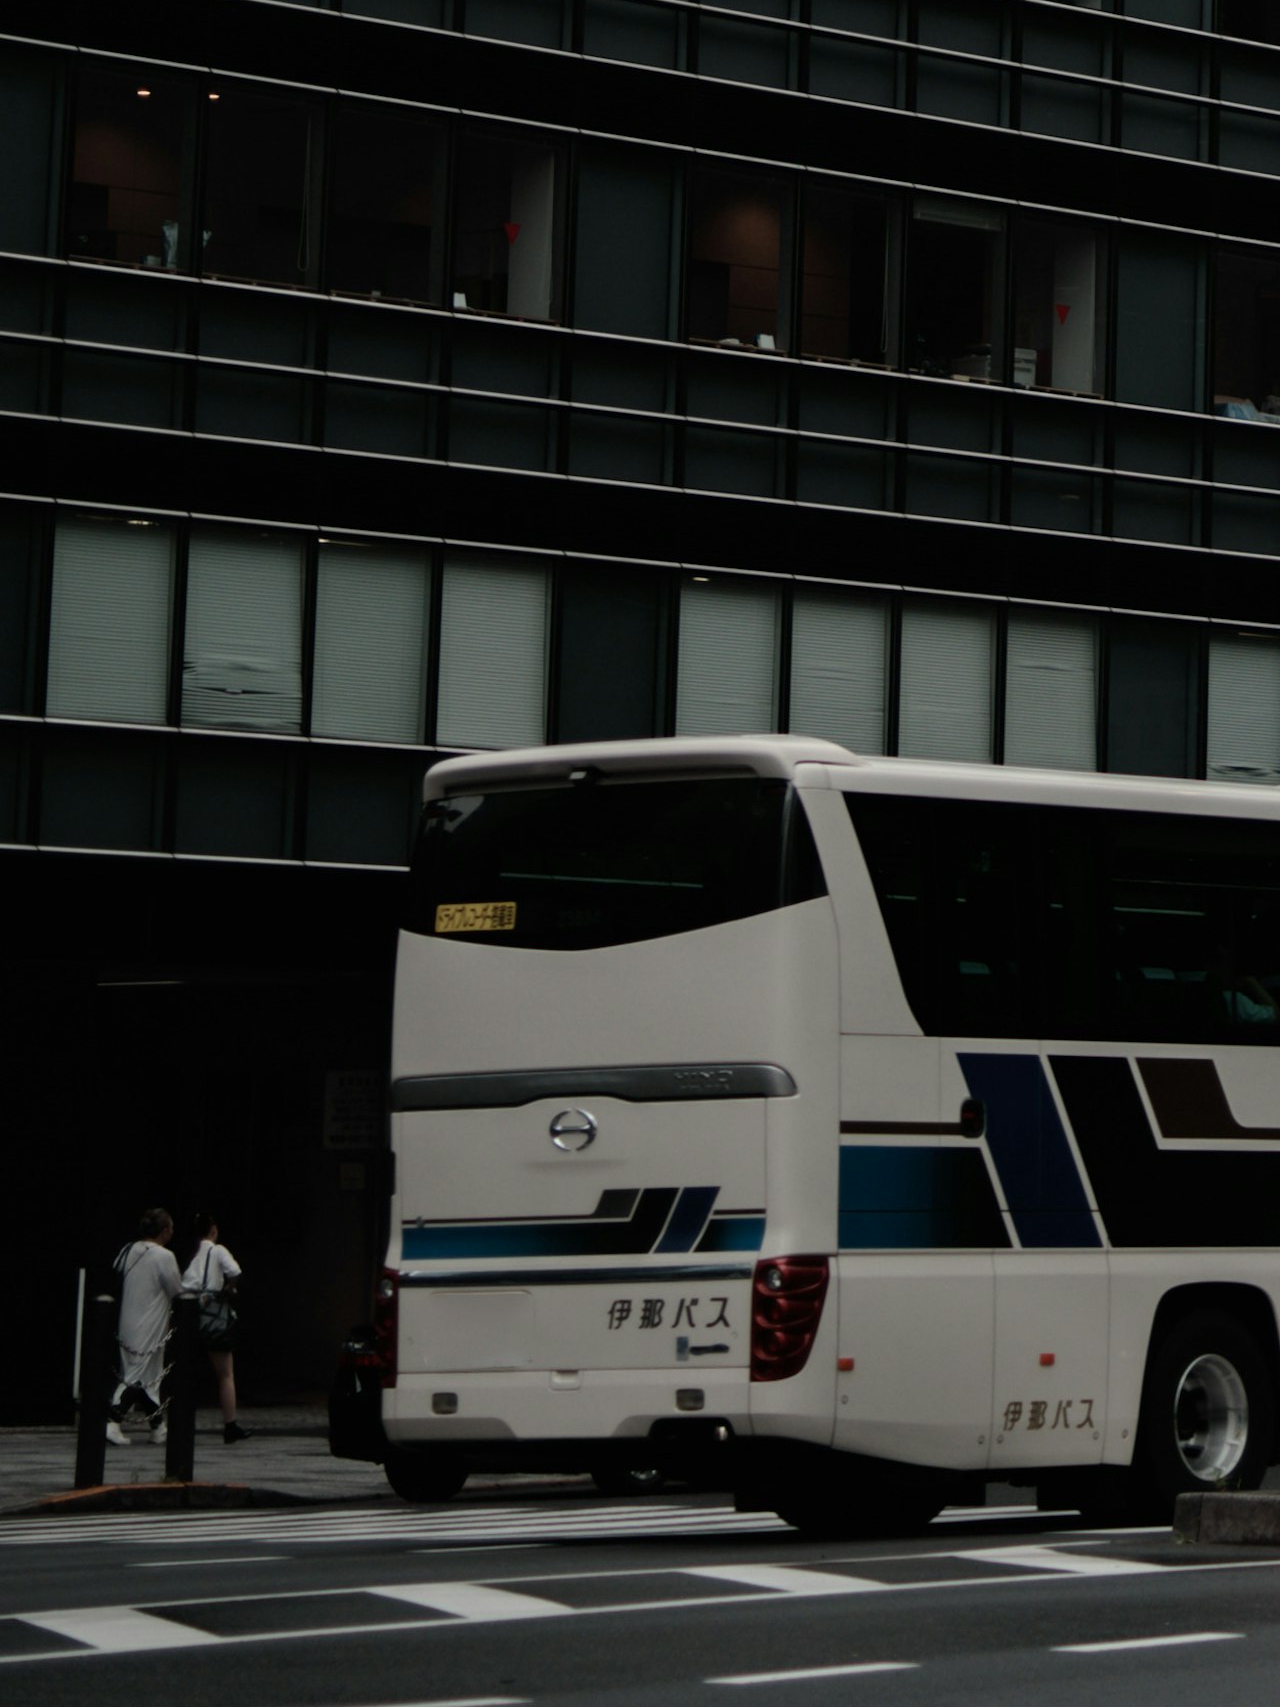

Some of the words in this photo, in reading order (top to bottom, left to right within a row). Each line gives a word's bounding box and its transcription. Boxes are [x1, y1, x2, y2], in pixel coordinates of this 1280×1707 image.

[607, 1297, 730, 1330] 伊那バス
[1003, 1399, 1095, 1432] 伊那バス
